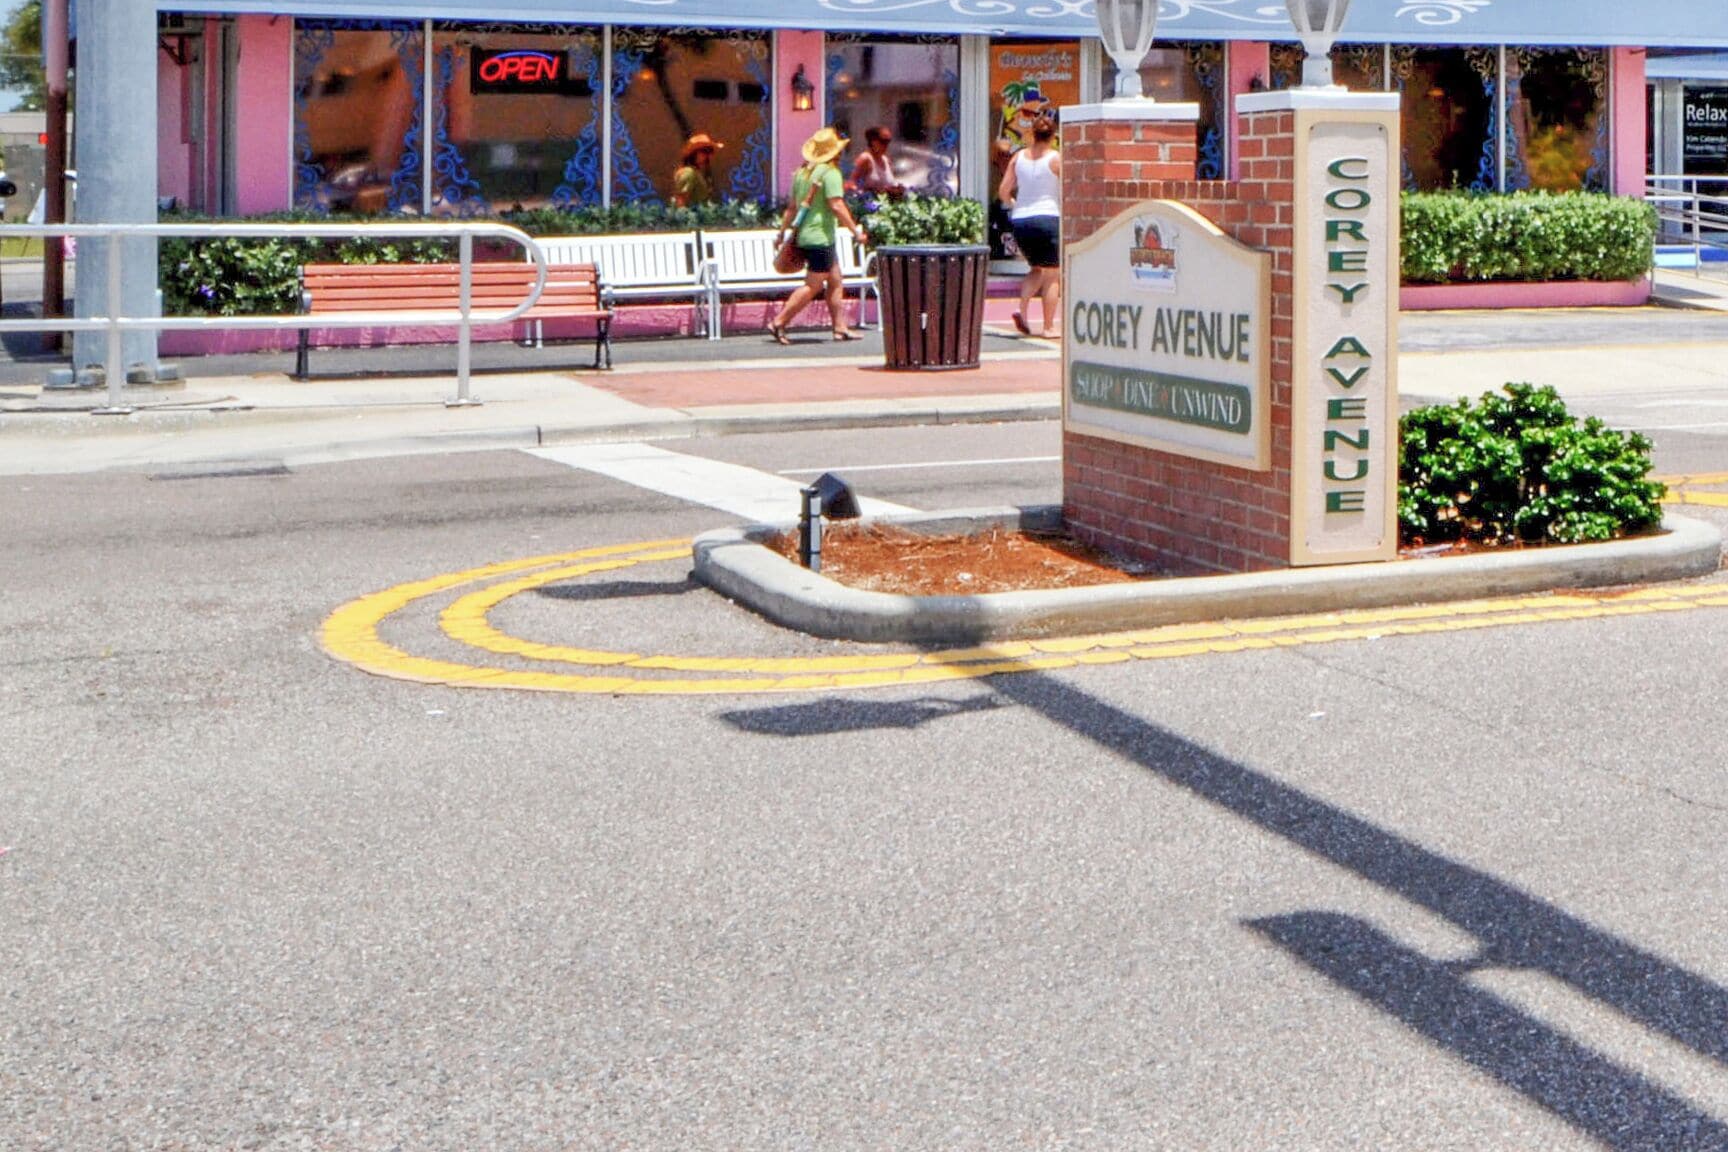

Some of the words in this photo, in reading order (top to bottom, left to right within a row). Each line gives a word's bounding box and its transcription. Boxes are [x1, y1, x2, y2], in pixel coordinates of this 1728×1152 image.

[480, 56, 560, 82] OPEN
[1686, 103, 1728, 121] Relax
[1324, 158, 1372, 304] COREY
[1073, 300, 1143, 350] COREY
[1150, 306, 1250, 363] AVENUE
[1076, 371, 1113, 400] SHOP
[1123, 377, 1158, 410] DINE
[1171, 385, 1243, 425] UNWIND
[1323, 336, 1372, 512] AVENUE
